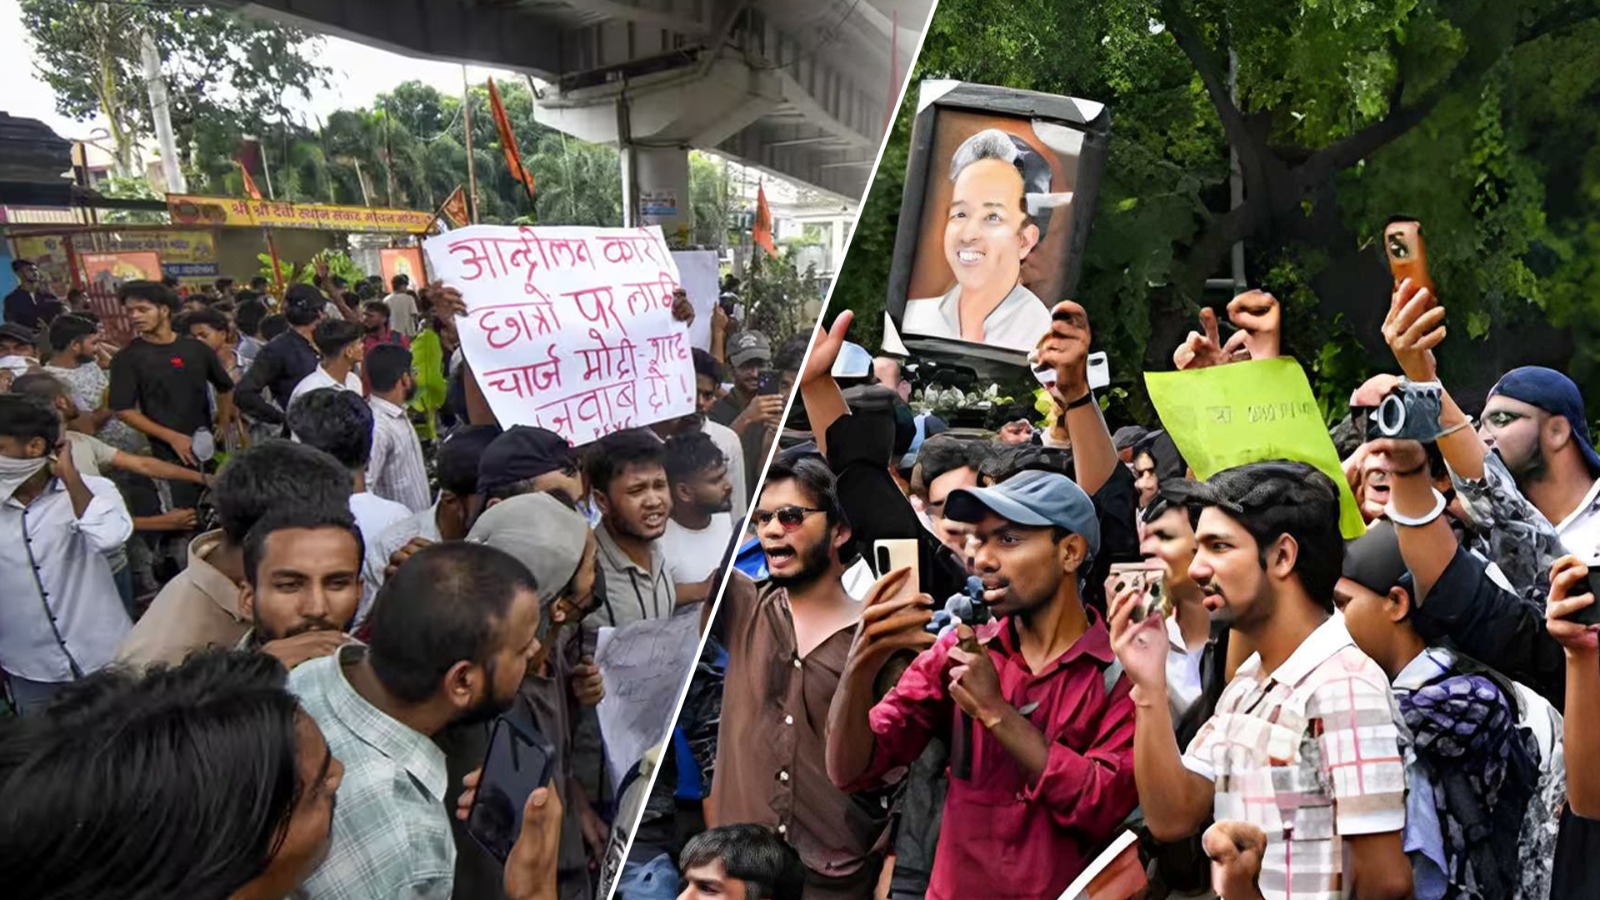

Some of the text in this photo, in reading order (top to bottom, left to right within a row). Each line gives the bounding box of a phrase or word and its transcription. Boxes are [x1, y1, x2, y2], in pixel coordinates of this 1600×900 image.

[231, 200, 250, 216] श्री
[252, 201, 270, 217] श्री
[560, 286, 627, 336] पर
[483, 343, 561, 398] चार्ज
